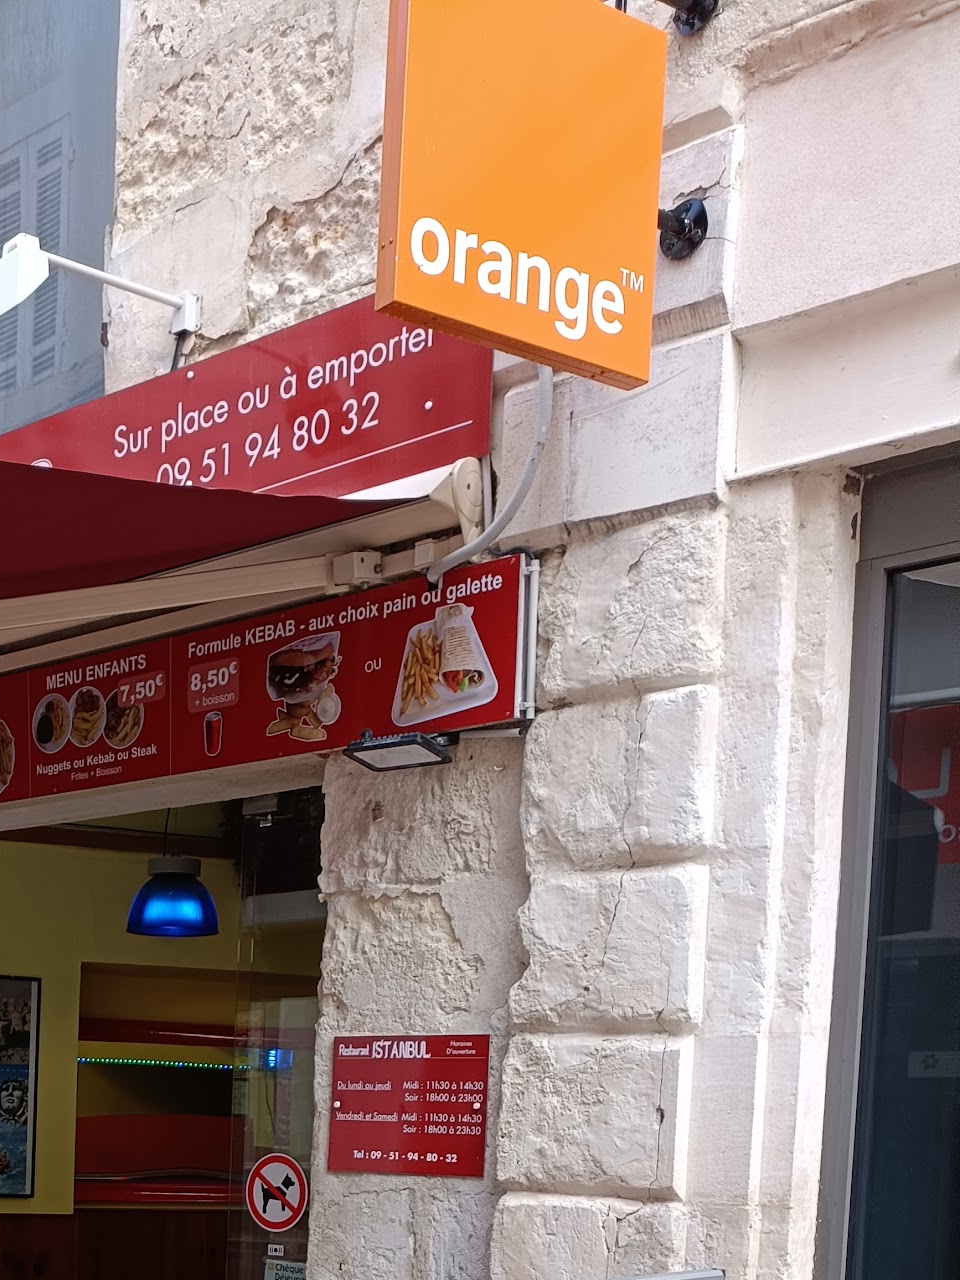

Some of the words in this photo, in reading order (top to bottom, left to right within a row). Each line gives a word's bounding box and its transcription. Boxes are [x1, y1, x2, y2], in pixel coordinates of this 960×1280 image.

[410, 217, 625, 341] orange
[113, 424, 153, 458] Sur
[161, 401, 229, 452] place
[238, 382, 269, 414] ou
[279, 366, 296, 398] à
[200, 443, 229, 482] 51
[245, 431, 281, 467] 94
[292, 408, 330, 446] 80
[341, 391, 381, 434] 32
[188, 634, 241, 658] Formule
[245, 620, 296, 645] KEBAB
[308, 614, 334, 631] aux
[339, 601, 379, 624] choix
[383, 594, 416, 618] pain
[421, 589, 440, 604] ou
[446, 574, 503, 605] galette
[46, 669, 82, 690] MENU
[86, 654, 146, 682] ENFANTS
[191, 661, 238, 692] 8,50€
[120, 674, 163, 704] 7,50€
[203, 691, 235, 706] boisson
[36, 759, 71, 776] Nuggets
[73, 758, 84, 769] ou
[87, 751, 115, 766] Kebab
[117, 750, 129, 761] ou
[131, 744, 157, 758] Steak
[71, 770, 89, 781] Frites
[96, 766, 122, 777] Boisson
[339, 1044, 369, 1055] Restaurant
[372, 1039, 431, 1058] ISTANBUL
[337, 1081, 347, 1090] Du
[348, 1081, 364, 1090] lundi
[375, 1081, 391, 1091] jeudi
[426, 1081, 449, 1090] 11h30
[451, 1081, 456, 1090] à
[460, 1082, 484, 1090] 14h30
[405, 1093, 418, 1101] Soir
[426, 1093, 449, 1102] 18h00
[451, 1094, 456, 1102] à
[458, 1094, 483, 1102] 23h00
[336, 1112, 364, 1120] Vendredi
[374, 1112, 398, 1121] Samedi
[402, 1113, 417, 1121] Midi
[425, 1113, 448, 1122] 11h30
[450, 1114, 455, 1122] à
[458, 1114, 482, 1122] 14h30
[403, 1125, 417, 1133] Soir
[424, 1125, 447, 1134] 18h00
[449, 1126, 454, 1134] à
[456, 1126, 481, 1135] 23h30
[353, 1150, 364, 1158] Tel
[371, 1151, 381, 1159] 09
[389, 1152, 399, 1160] 51
[426, 1154, 437, 1162] 80
[446, 1154, 457, 1162] 32
[275, 1263, 304, 1274] Chèque
